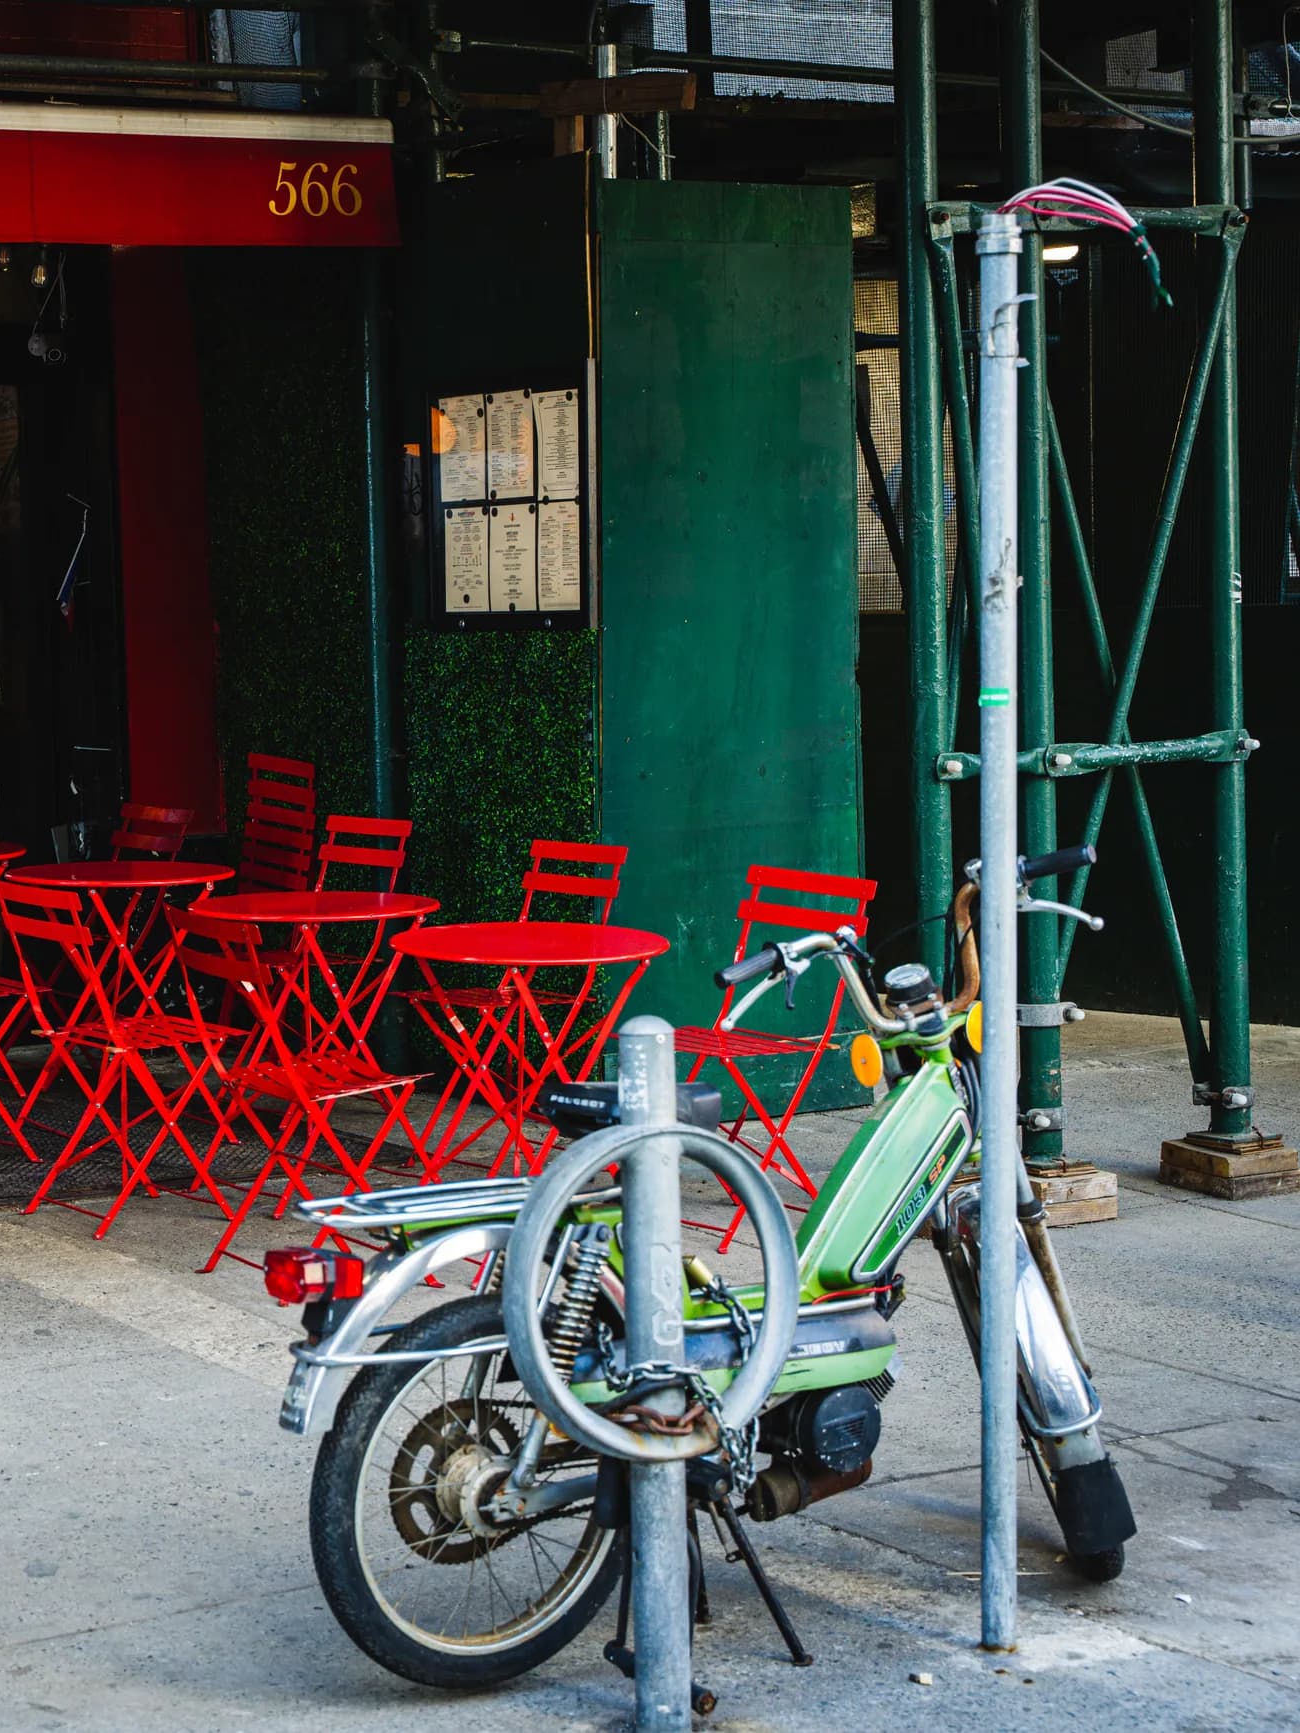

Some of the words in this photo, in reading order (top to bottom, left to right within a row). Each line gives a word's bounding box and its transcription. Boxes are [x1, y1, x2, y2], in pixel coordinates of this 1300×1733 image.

[268, 161, 363, 217] 566
[549, 1094, 607, 1109] PEUGEOT
[895, 1183, 927, 1236] 103
[928, 1154, 948, 1185] SP
